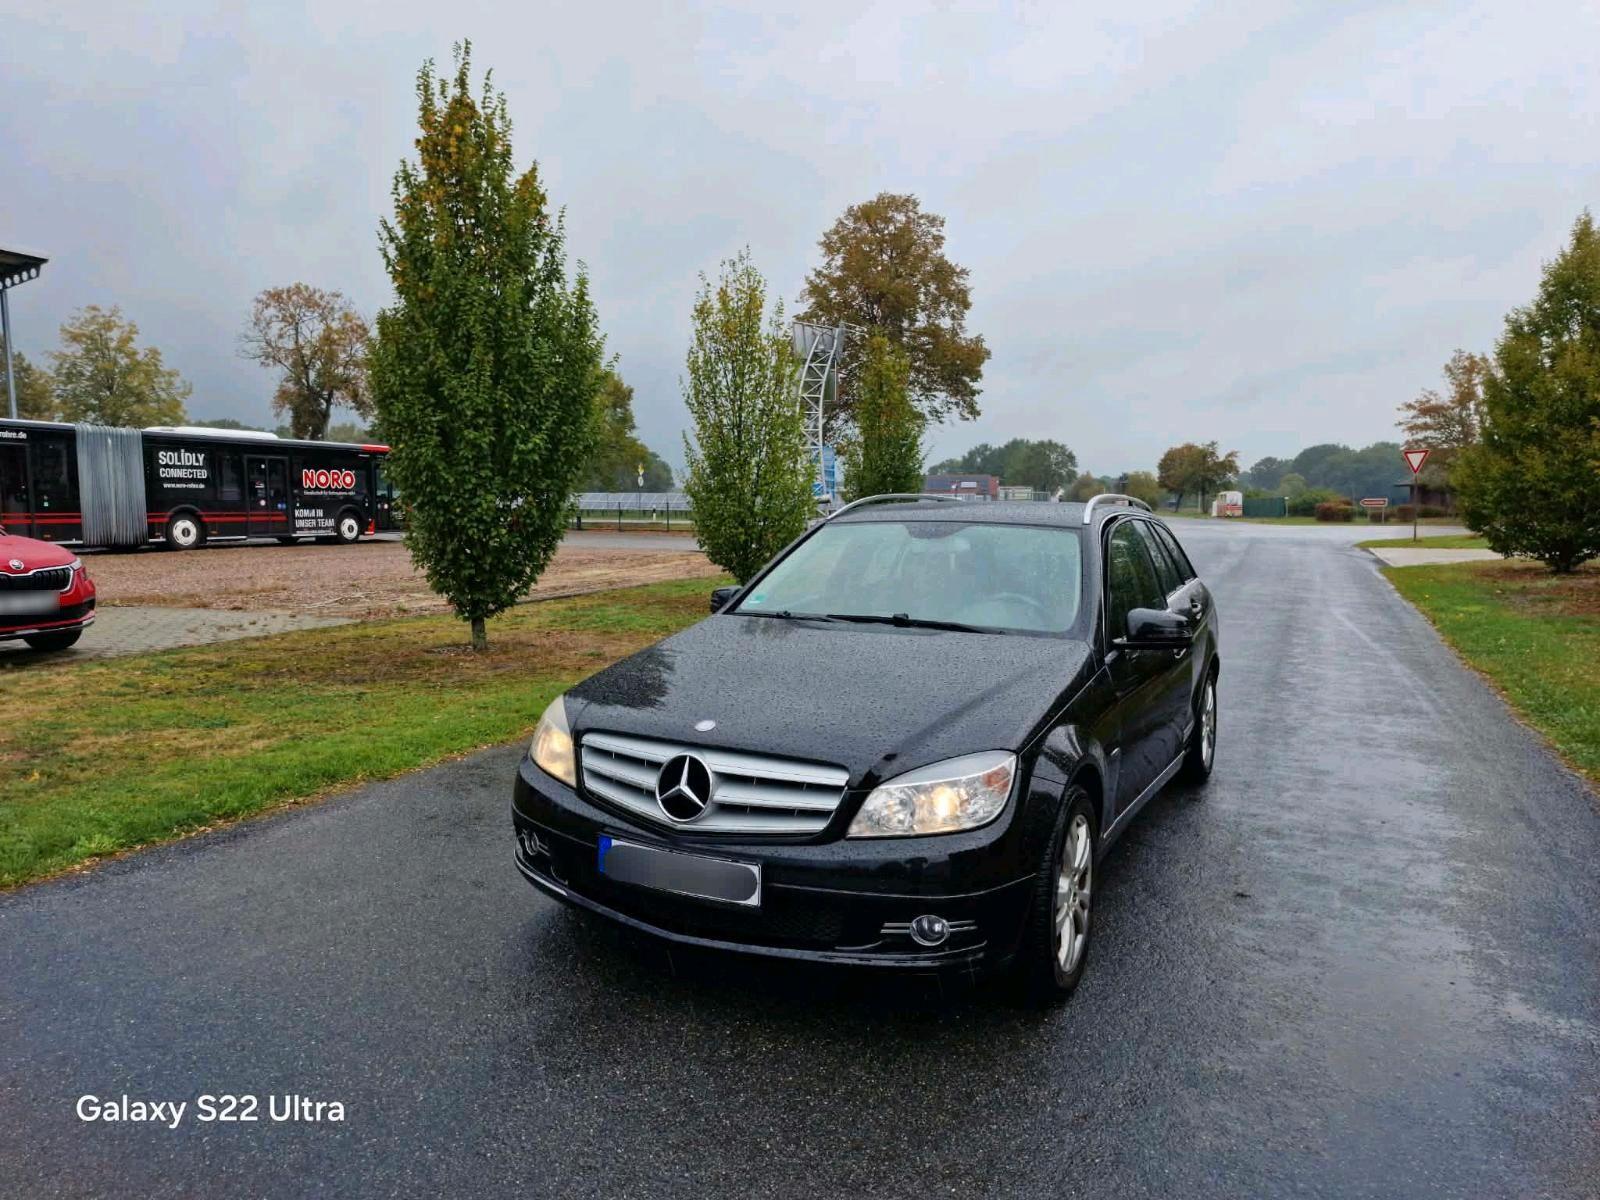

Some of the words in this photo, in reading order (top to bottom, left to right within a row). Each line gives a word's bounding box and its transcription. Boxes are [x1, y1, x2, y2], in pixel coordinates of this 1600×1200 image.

[159, 468, 207, 479] CONNECTED
[302, 469, 356, 489] NORO
[316, 508, 324, 518] IN
[295, 518, 316, 528] UNSER
[317, 518, 335, 528] TEAM
